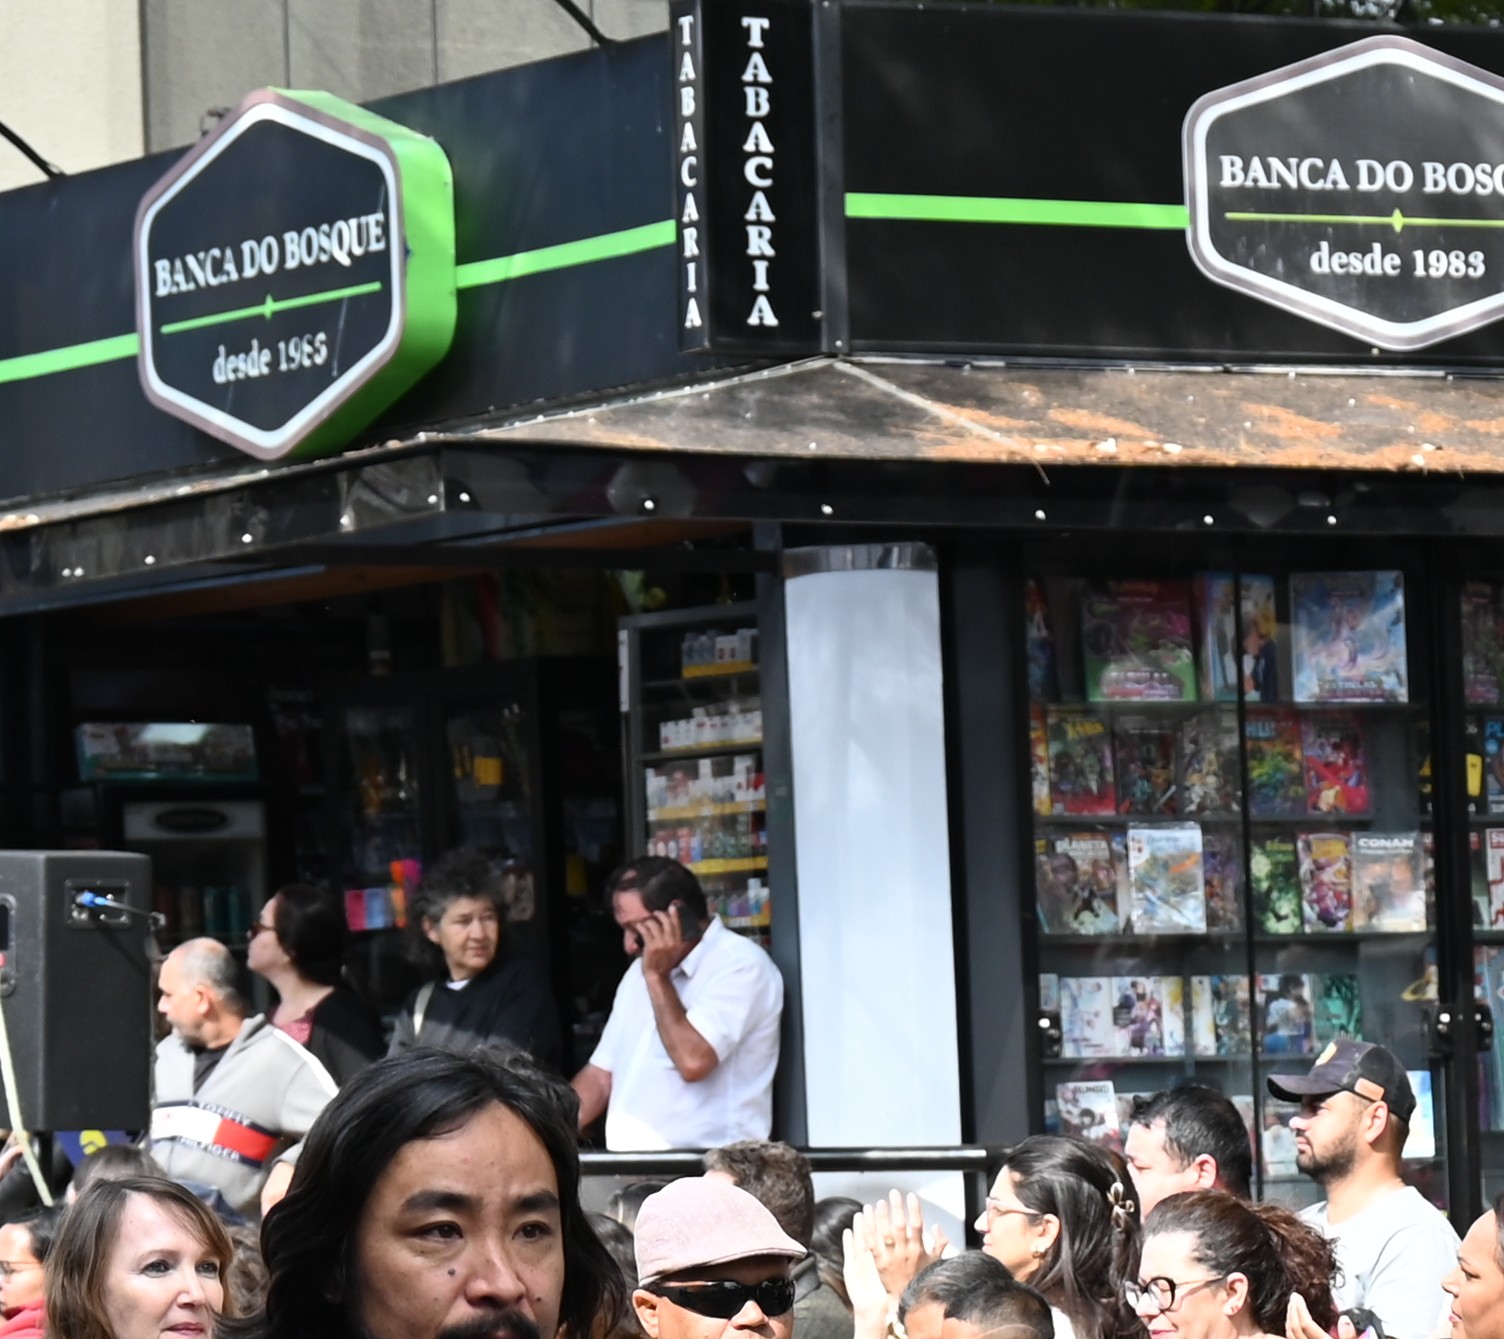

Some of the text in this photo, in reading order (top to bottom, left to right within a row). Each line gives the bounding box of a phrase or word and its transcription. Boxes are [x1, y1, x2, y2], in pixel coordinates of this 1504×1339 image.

[678, 14, 702, 330] TABACARIA
[740, 16, 780, 327] TABACARIA
[1219, 155, 1350, 190] BANCA
[1355, 159, 1413, 193] DO
[154, 211, 386, 298] BANCA DO BOSQUE
[1309, 241, 1486, 278] desde 1983
[212, 338, 272, 384] desde
[1358, 837, 1413, 848] CONAN
